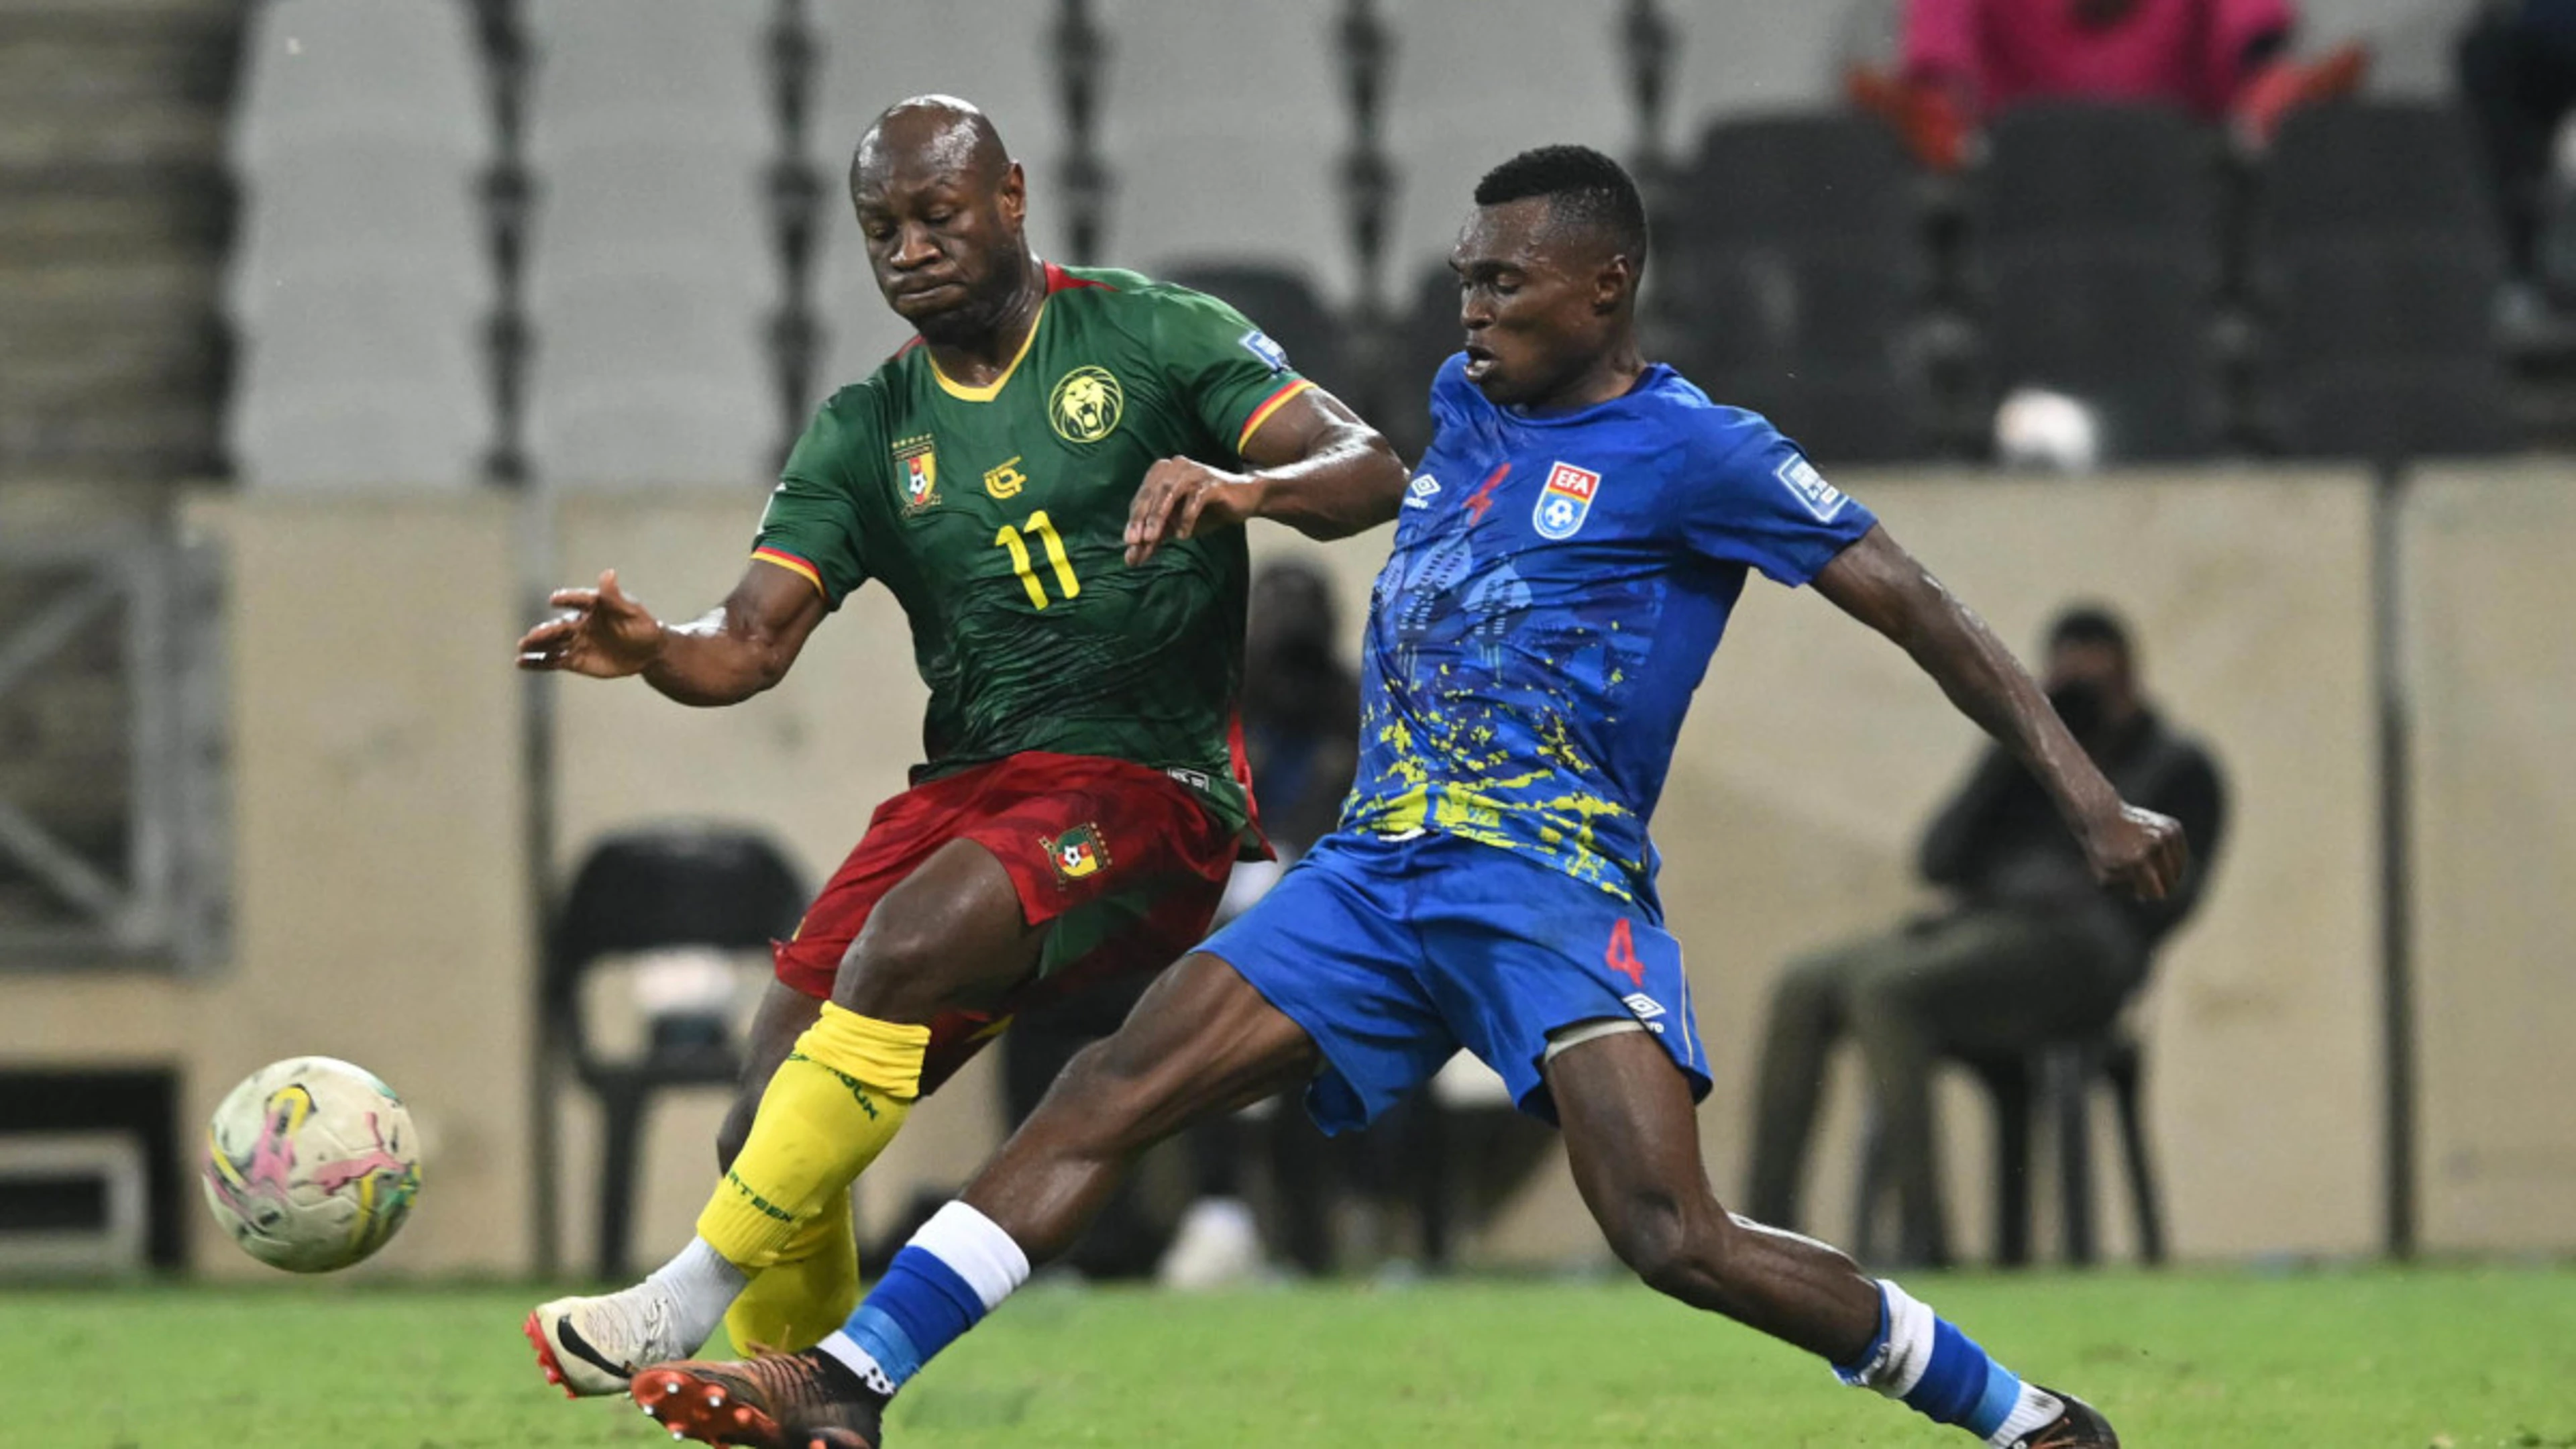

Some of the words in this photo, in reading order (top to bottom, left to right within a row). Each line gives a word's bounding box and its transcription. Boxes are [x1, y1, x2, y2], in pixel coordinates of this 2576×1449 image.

[1462, 463, 1511, 527] 4
[1555, 469, 1589, 495] EFA
[995, 511, 1081, 610] 11
[1606, 917, 1644, 987] 4
